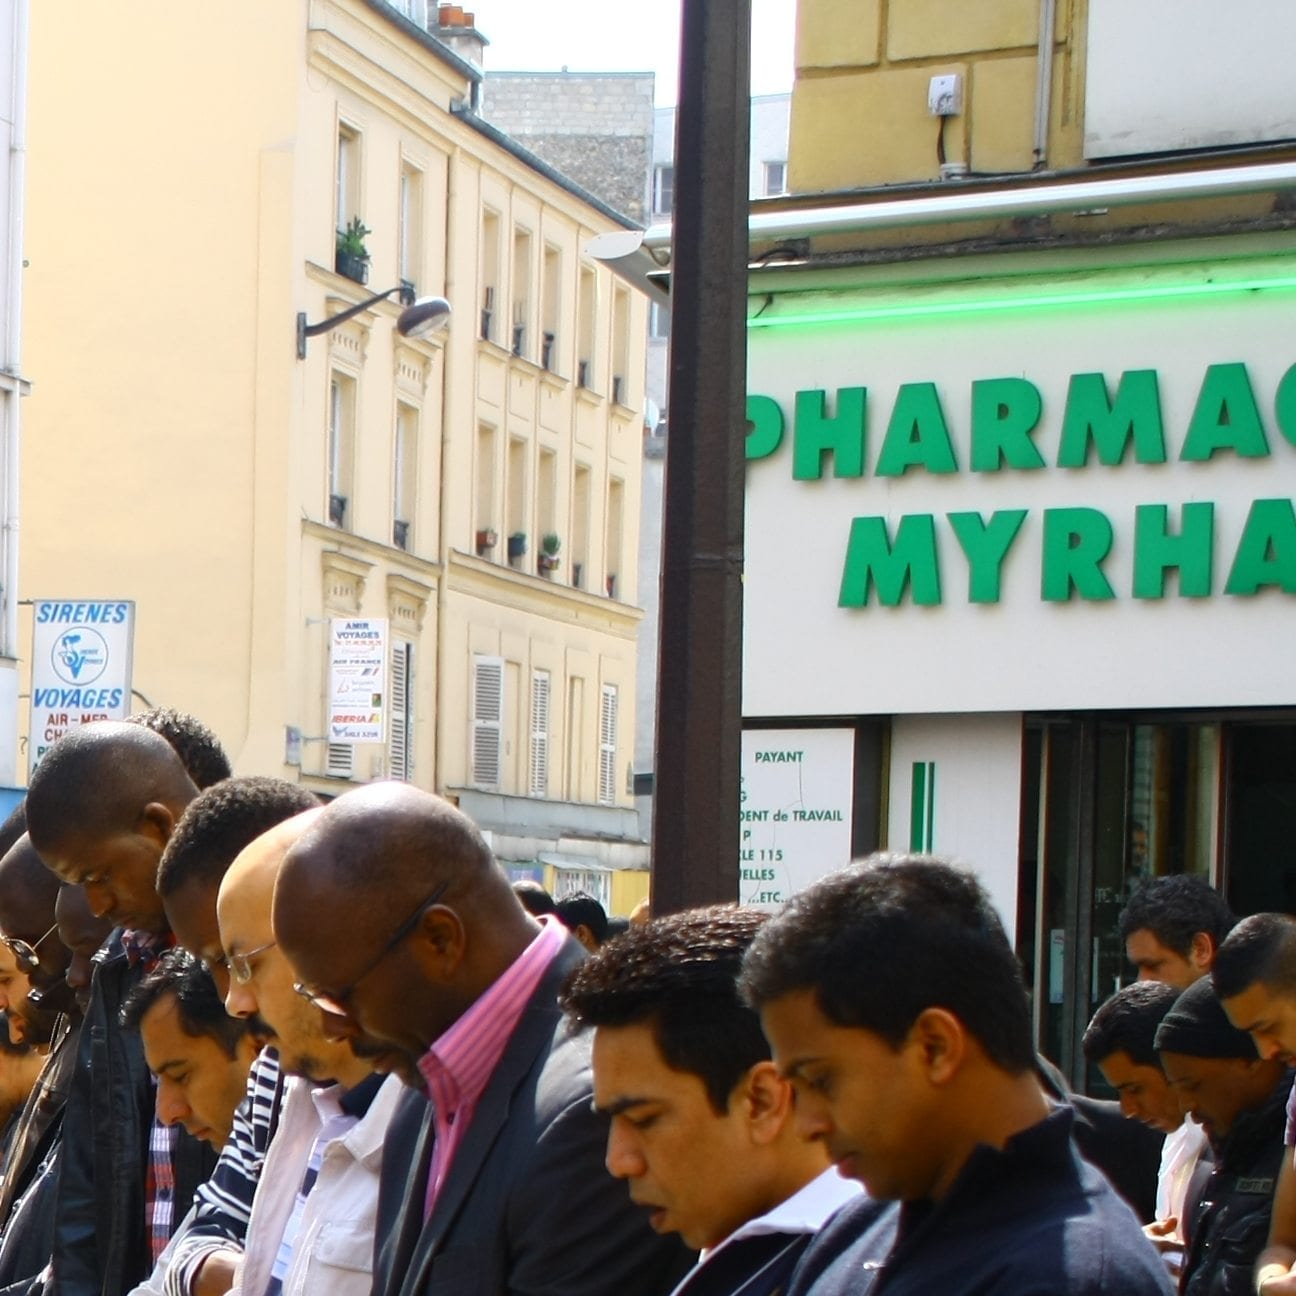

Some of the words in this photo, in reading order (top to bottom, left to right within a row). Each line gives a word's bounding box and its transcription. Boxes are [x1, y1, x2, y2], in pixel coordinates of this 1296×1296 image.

[838, 499, 1296, 609] MYRHA
[37, 602, 127, 624] SIRENES
[336, 631, 380, 640] VOYAGES
[33, 688, 123, 709] VOYAGES
[47, 713, 69, 726] AIR
[332, 714, 367, 724] IBERIA
[755, 751, 804, 763] PAYANT
[739, 810, 769, 822] DENT
[773, 809, 788, 822] de
[793, 809, 843, 822] TRAVAIL
[760, 849, 783, 861] 115
